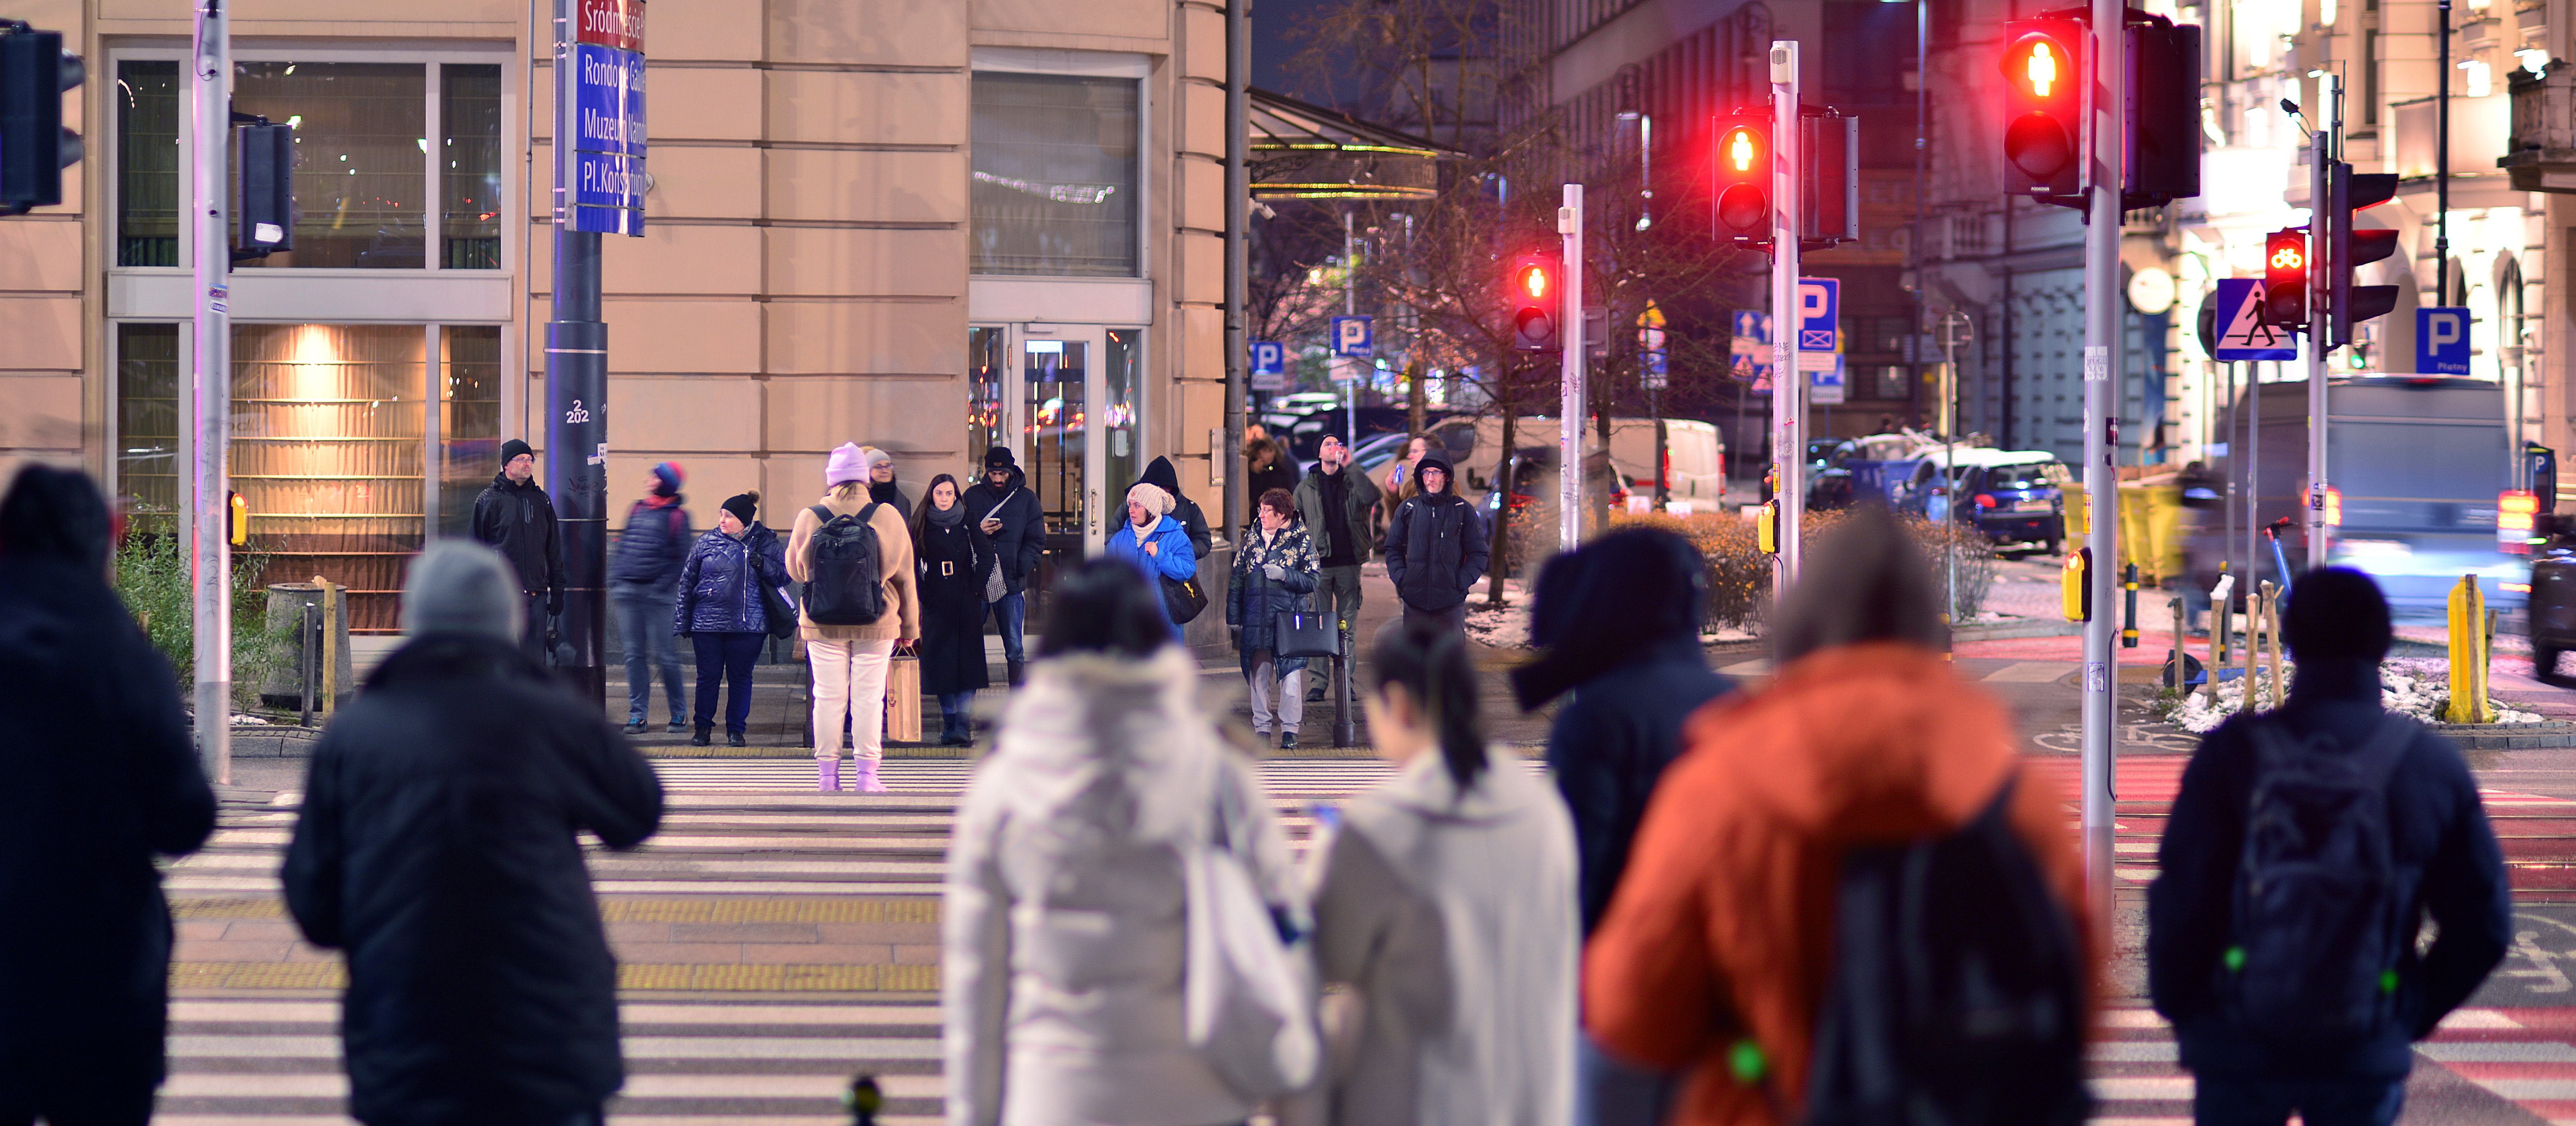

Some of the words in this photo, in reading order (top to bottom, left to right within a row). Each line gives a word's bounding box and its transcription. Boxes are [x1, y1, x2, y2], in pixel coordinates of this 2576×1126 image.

[585, 54, 617, 87] Rondo
[1798, 284, 1828, 330] P
[1340, 320, 1365, 353] P
[2429, 313, 2460, 356] P
[1258, 344, 1278, 370] P
[566, 410, 589, 423] 202
[573, 400, 581, 412] 2
[2535, 456, 2545, 470] P
